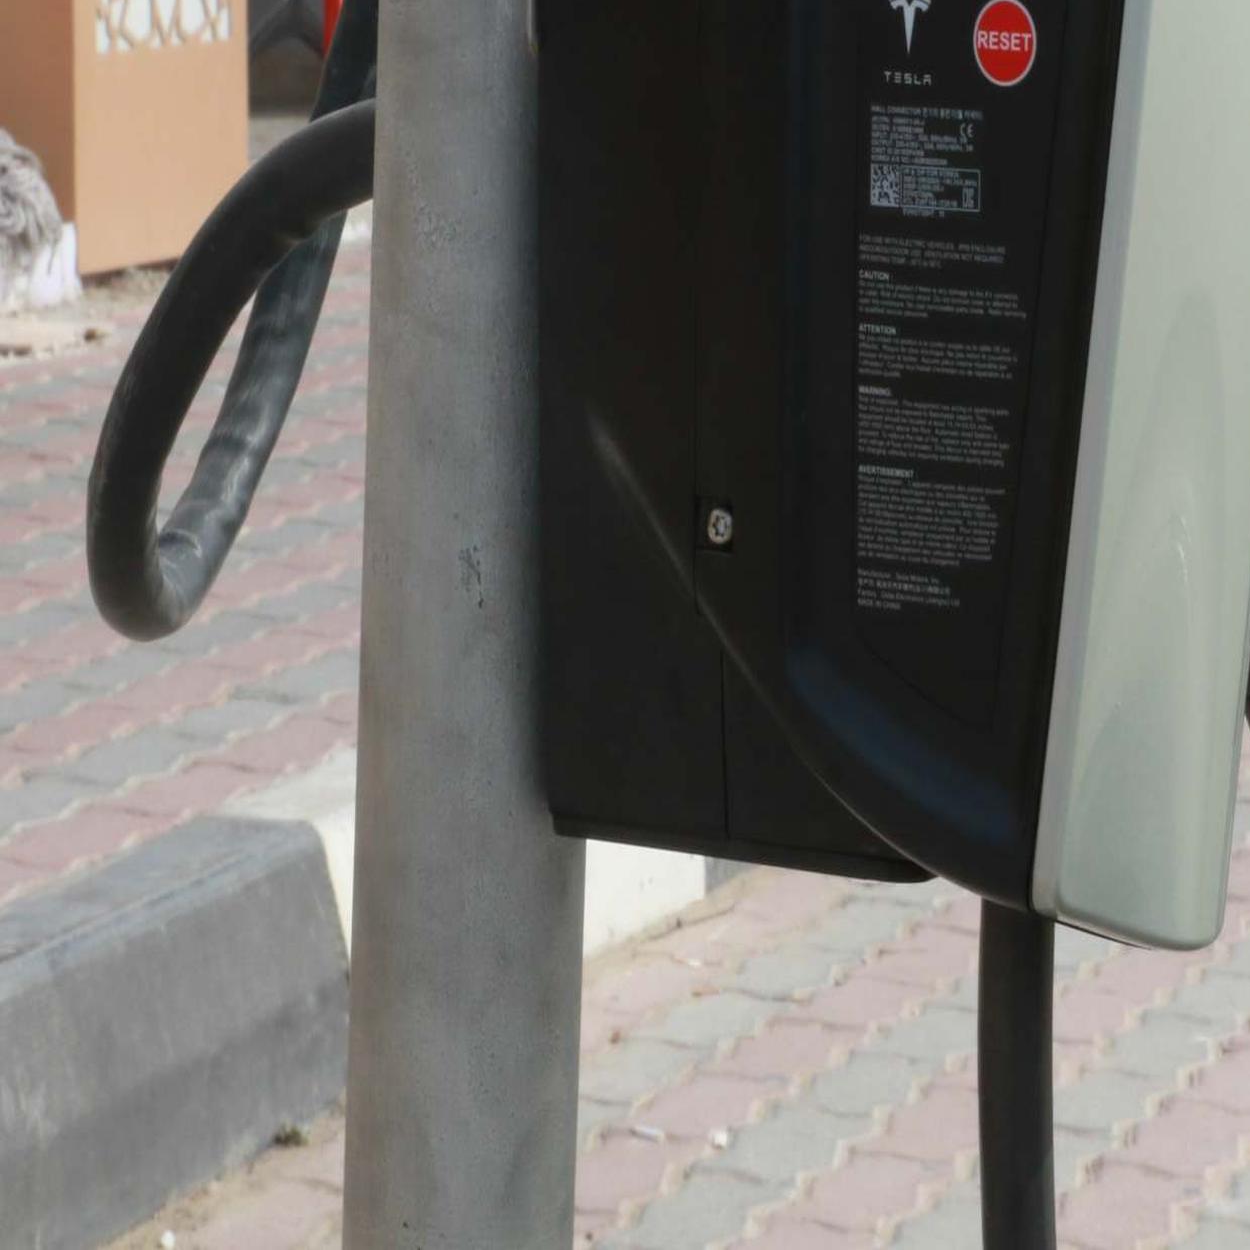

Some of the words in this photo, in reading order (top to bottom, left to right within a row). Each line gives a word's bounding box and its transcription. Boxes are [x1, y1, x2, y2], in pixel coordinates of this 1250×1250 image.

[977, 30, 1032, 52] RESET
[883, 70, 932, 85] TESLA
[859, 269, 890, 280] CAUTION
[859, 323, 896, 334] ATTENTION
